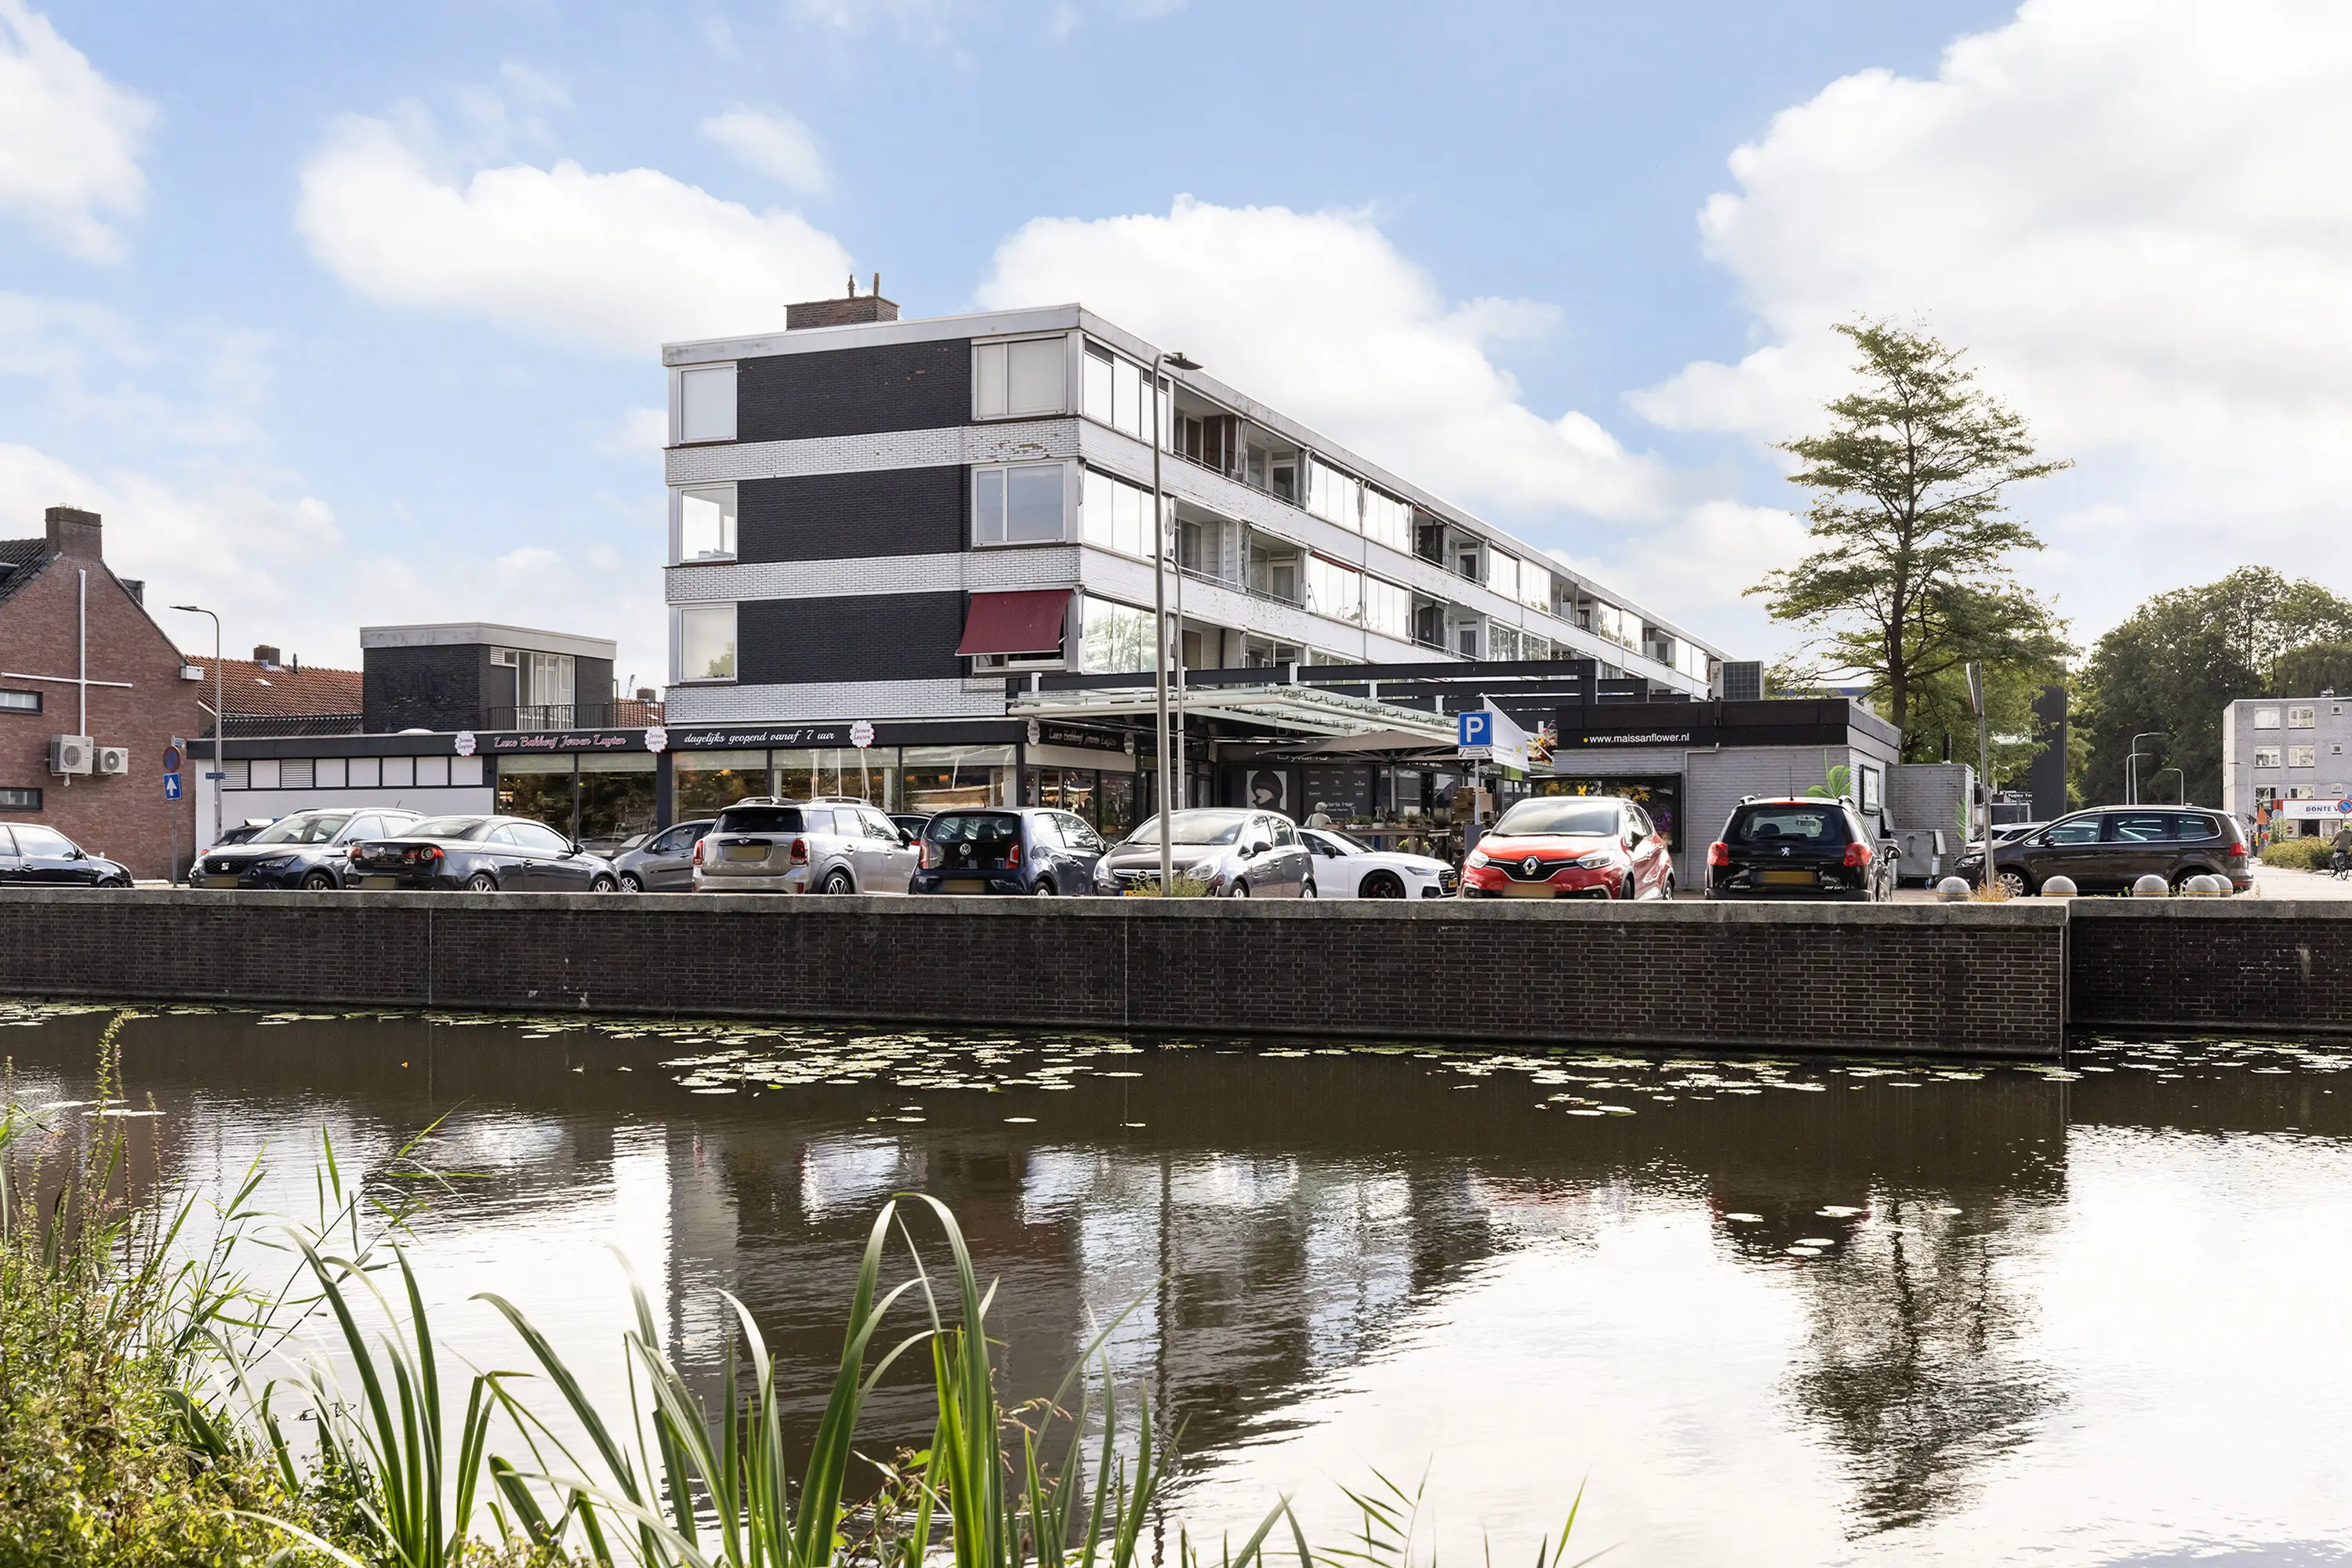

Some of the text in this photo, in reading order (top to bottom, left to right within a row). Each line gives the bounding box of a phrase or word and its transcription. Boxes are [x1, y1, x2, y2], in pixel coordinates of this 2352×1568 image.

[684, 731, 725, 745] dagelijks
[728, 731, 767, 745] geopend
[770, 729, 802, 742] vanaf
[806, 729, 815, 740] 7
[1466, 717, 1484, 742] P
[520, 735, 559, 749] Bakkerij
[560, 735, 591, 748] Jeroen
[1589, 732, 1690, 743] www.maissanflower.nl
